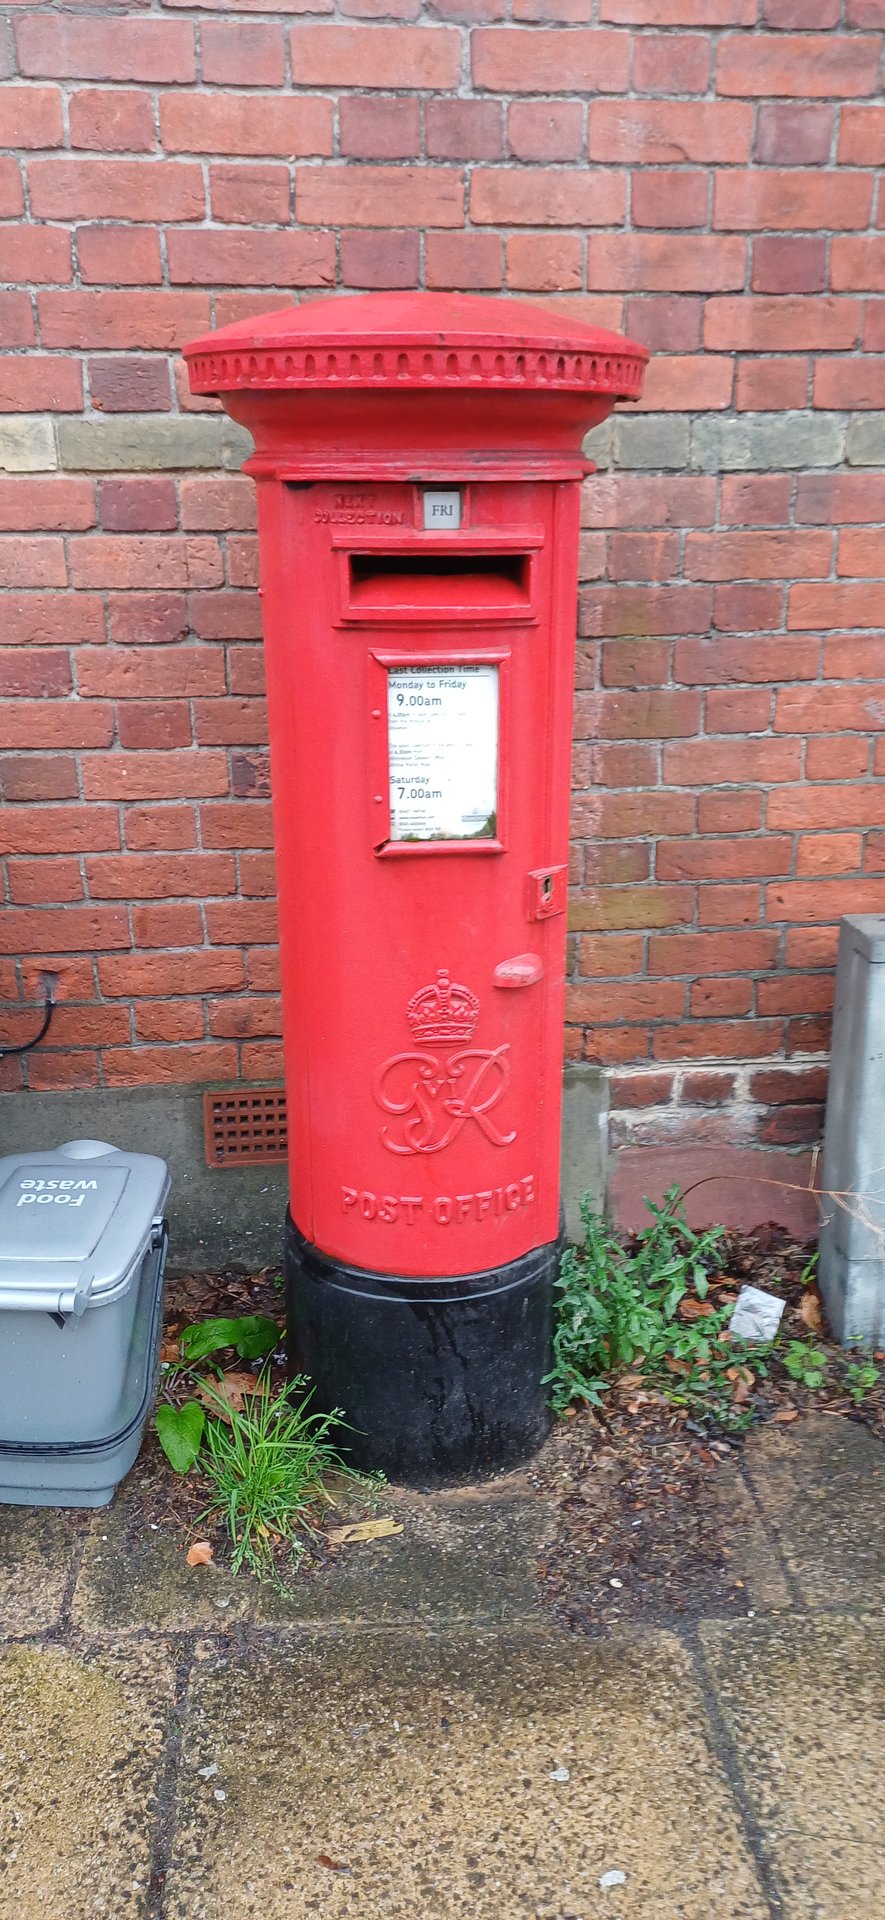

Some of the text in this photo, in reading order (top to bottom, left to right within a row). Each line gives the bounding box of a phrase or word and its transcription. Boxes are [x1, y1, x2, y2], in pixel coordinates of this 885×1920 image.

[432, 505, 453, 516] FRI
[314, 509, 404, 525] COLLECTION
[388, 664, 480, 675] Last Collection Time
[388, 680, 467, 690] Monday to Friday
[396, 693, 443, 706] 9.00am
[389, 775, 431, 785] Saturday
[397, 787, 443, 800] 7.00am
[20, 1180, 98, 1191] waste
[16, 1193, 86, 1207] Food
[340, 1174, 535, 1225] POST OFFICE
